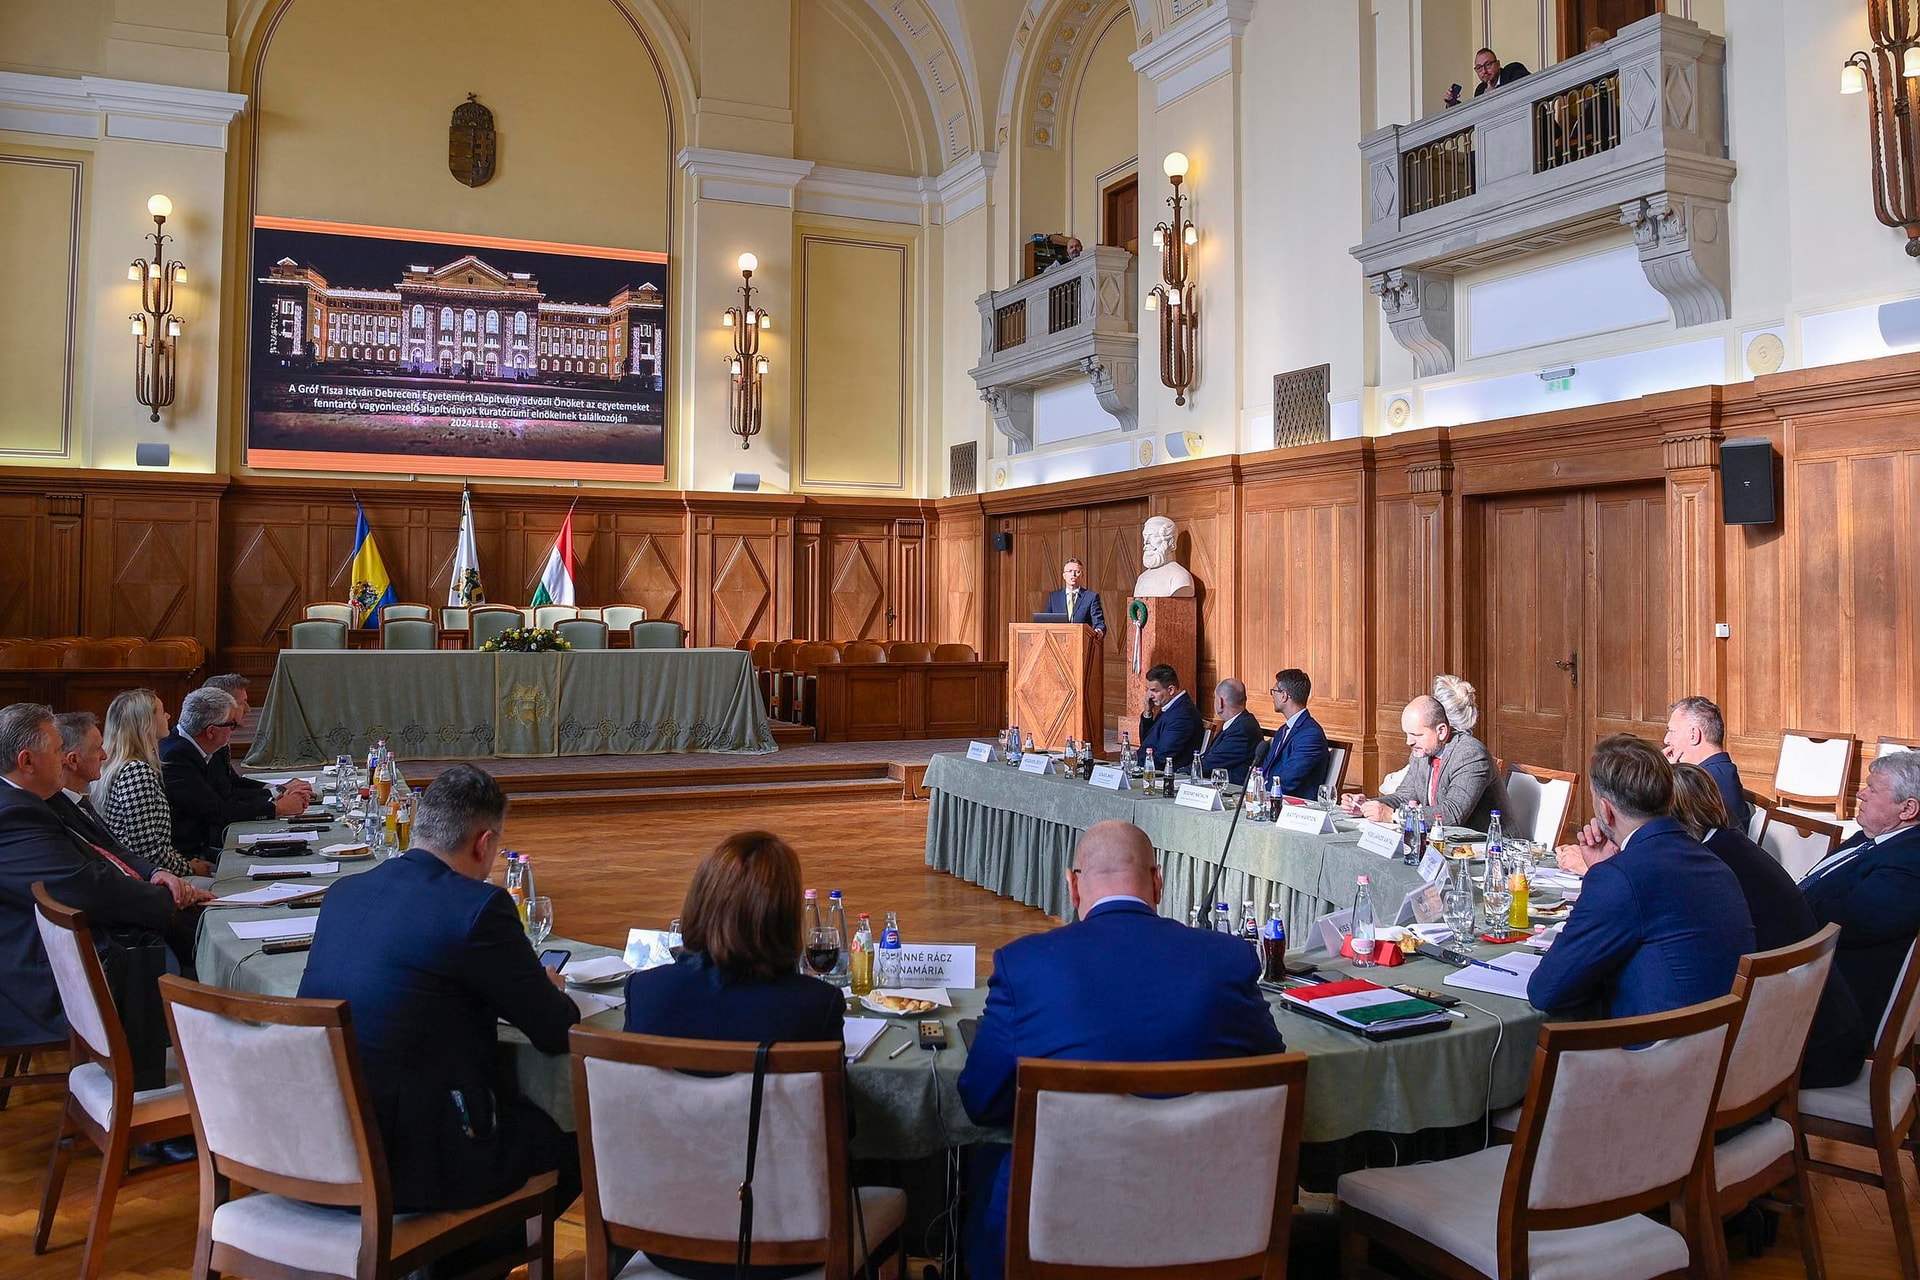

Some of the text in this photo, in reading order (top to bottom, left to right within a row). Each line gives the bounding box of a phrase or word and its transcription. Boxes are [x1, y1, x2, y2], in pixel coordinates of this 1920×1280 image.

[288, 384, 296, 393] A
[298, 384, 319, 394] Gróf
[321, 385, 343, 395] Tisza
[345, 387, 373, 397] István
[375, 388, 420, 399] Debreceni
[422, 391, 473, 402] Egyetemért
[474, 394, 520, 405] Alapítvány
[522, 396, 552, 406] üdvözli
[554, 397, 584, 408] Önöket
[597, 402, 650, 412] egyetemeket
[313, 398, 357, 409] fenntartó
[421, 404, 478, 416] alapítványok
[479, 407, 529, 417] kuratóriumi
[531, 410, 577, 420] elnökeinek
[578, 412, 628, 424] találkozóján
[451, 418, 501, 429] 2024.11.16.
[927, 952, 952, 963] RÁCZ
